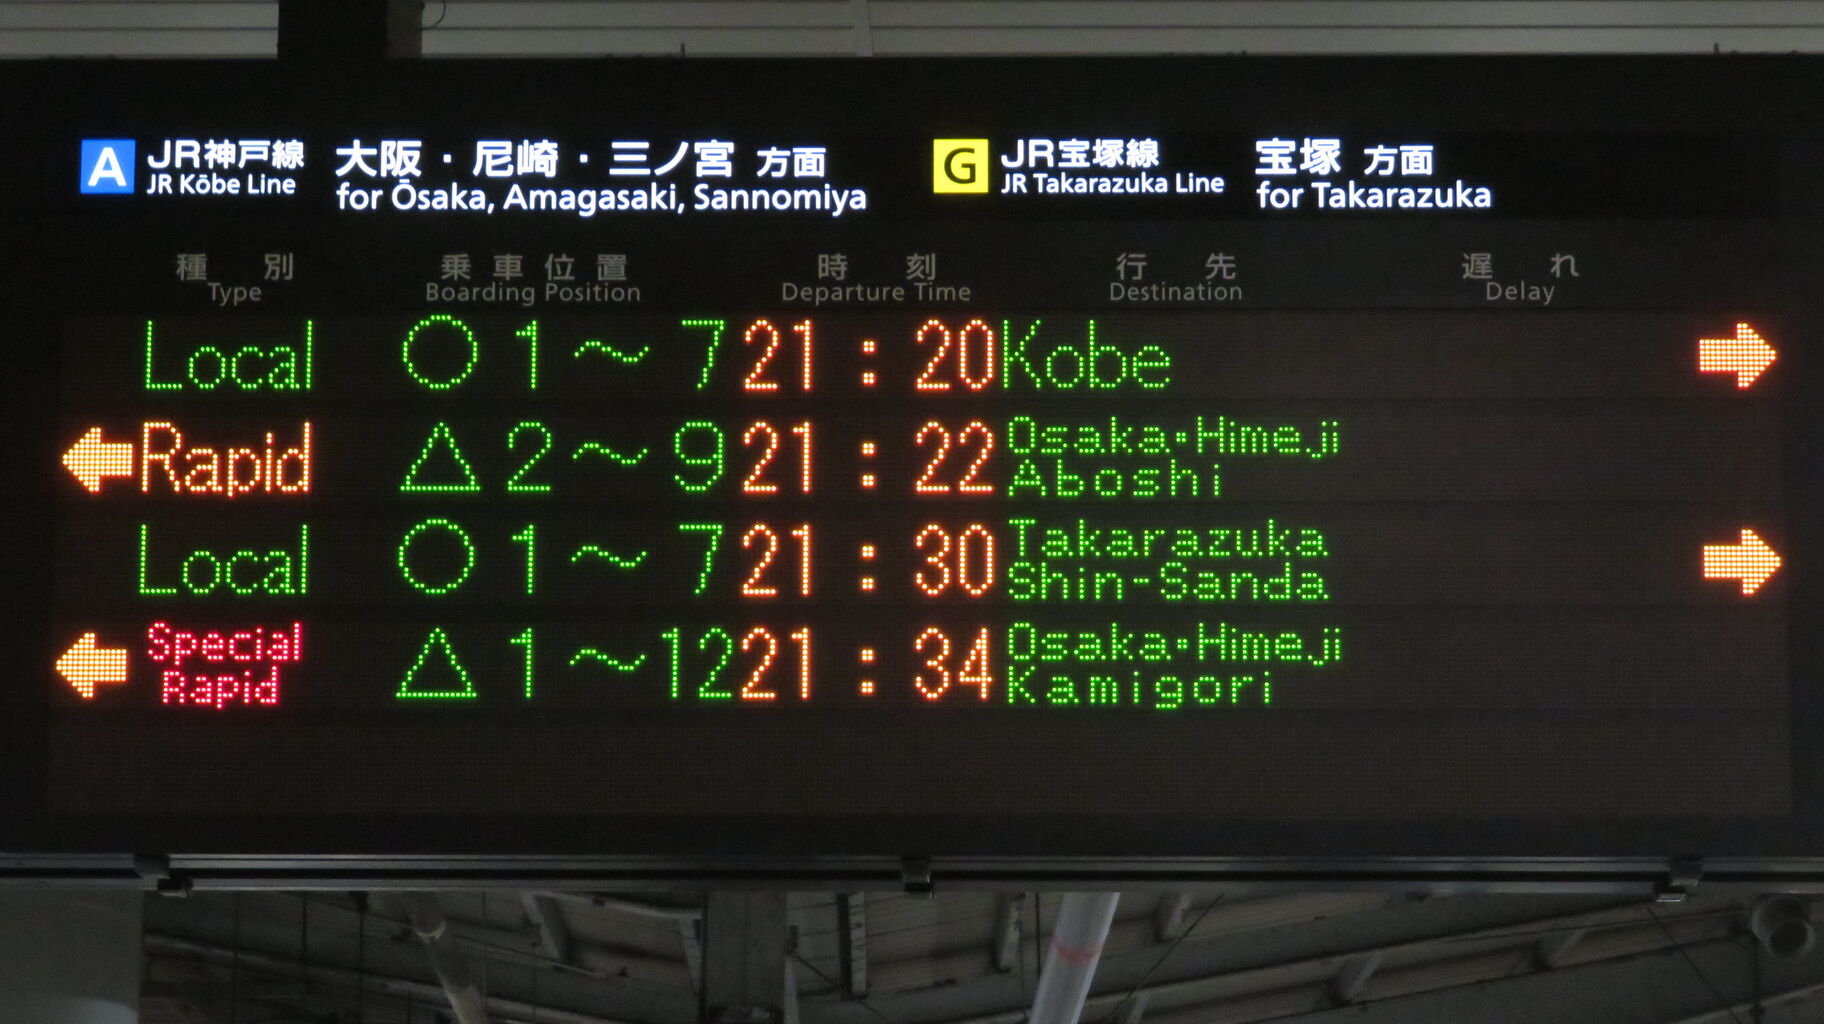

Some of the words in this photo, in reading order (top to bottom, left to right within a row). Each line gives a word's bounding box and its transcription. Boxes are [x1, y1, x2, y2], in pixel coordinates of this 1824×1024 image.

[87, 147, 127, 187] A
[147, 139, 305, 170] JR神戸線
[756, 146, 827, 177] 方面
[944, 149, 976, 184] G
[1000, 138, 1160, 169] JR宝塚線
[1254, 137, 1342, 177] 宝塚
[1363, 144, 1434, 177] 方面
[146, 172, 173, 195] JR
[179, 173, 241, 195] Kōbe
[247, 174, 297, 195] Line
[335, 181, 384, 211] for
[391, 175, 496, 215] Ōsaka,
[502, 182, 685, 218] Amagasaki,
[693, 183, 867, 218] Sannomiya
[1000, 173, 1028, 194] JR
[1032, 170, 1169, 194] Takarazuka
[1175, 173, 1225, 194] Line
[1255, 180, 1305, 209] for
[1309, 180, 1493, 209] Takarazuka
[441, 254, 627, 281] 乗車位置
[208, 283, 262, 304] Type
[426, 283, 535, 307] Boarding
[545, 283, 640, 302] Position
[782, 283, 905, 306] Departure
[914, 282, 971, 302] Time
[1110, 282, 1242, 301] Destination
[1486, 282, 1555, 305] Delay
[145, 320, 313, 390] Local
[1003, 320, 1171, 389] Kobe
[140, 422, 313, 499] Rapid
[1008, 459, 1220, 497] Aboshi
[1008, 519, 1329, 558] Takarazuka
[139, 525, 308, 595] Local
[1008, 562, 1329, 601] Shin-Sanda
[147, 621, 304, 665] Special
[161, 664, 281, 709] Rapid
[1007, 666, 1271, 710] Kamigori
